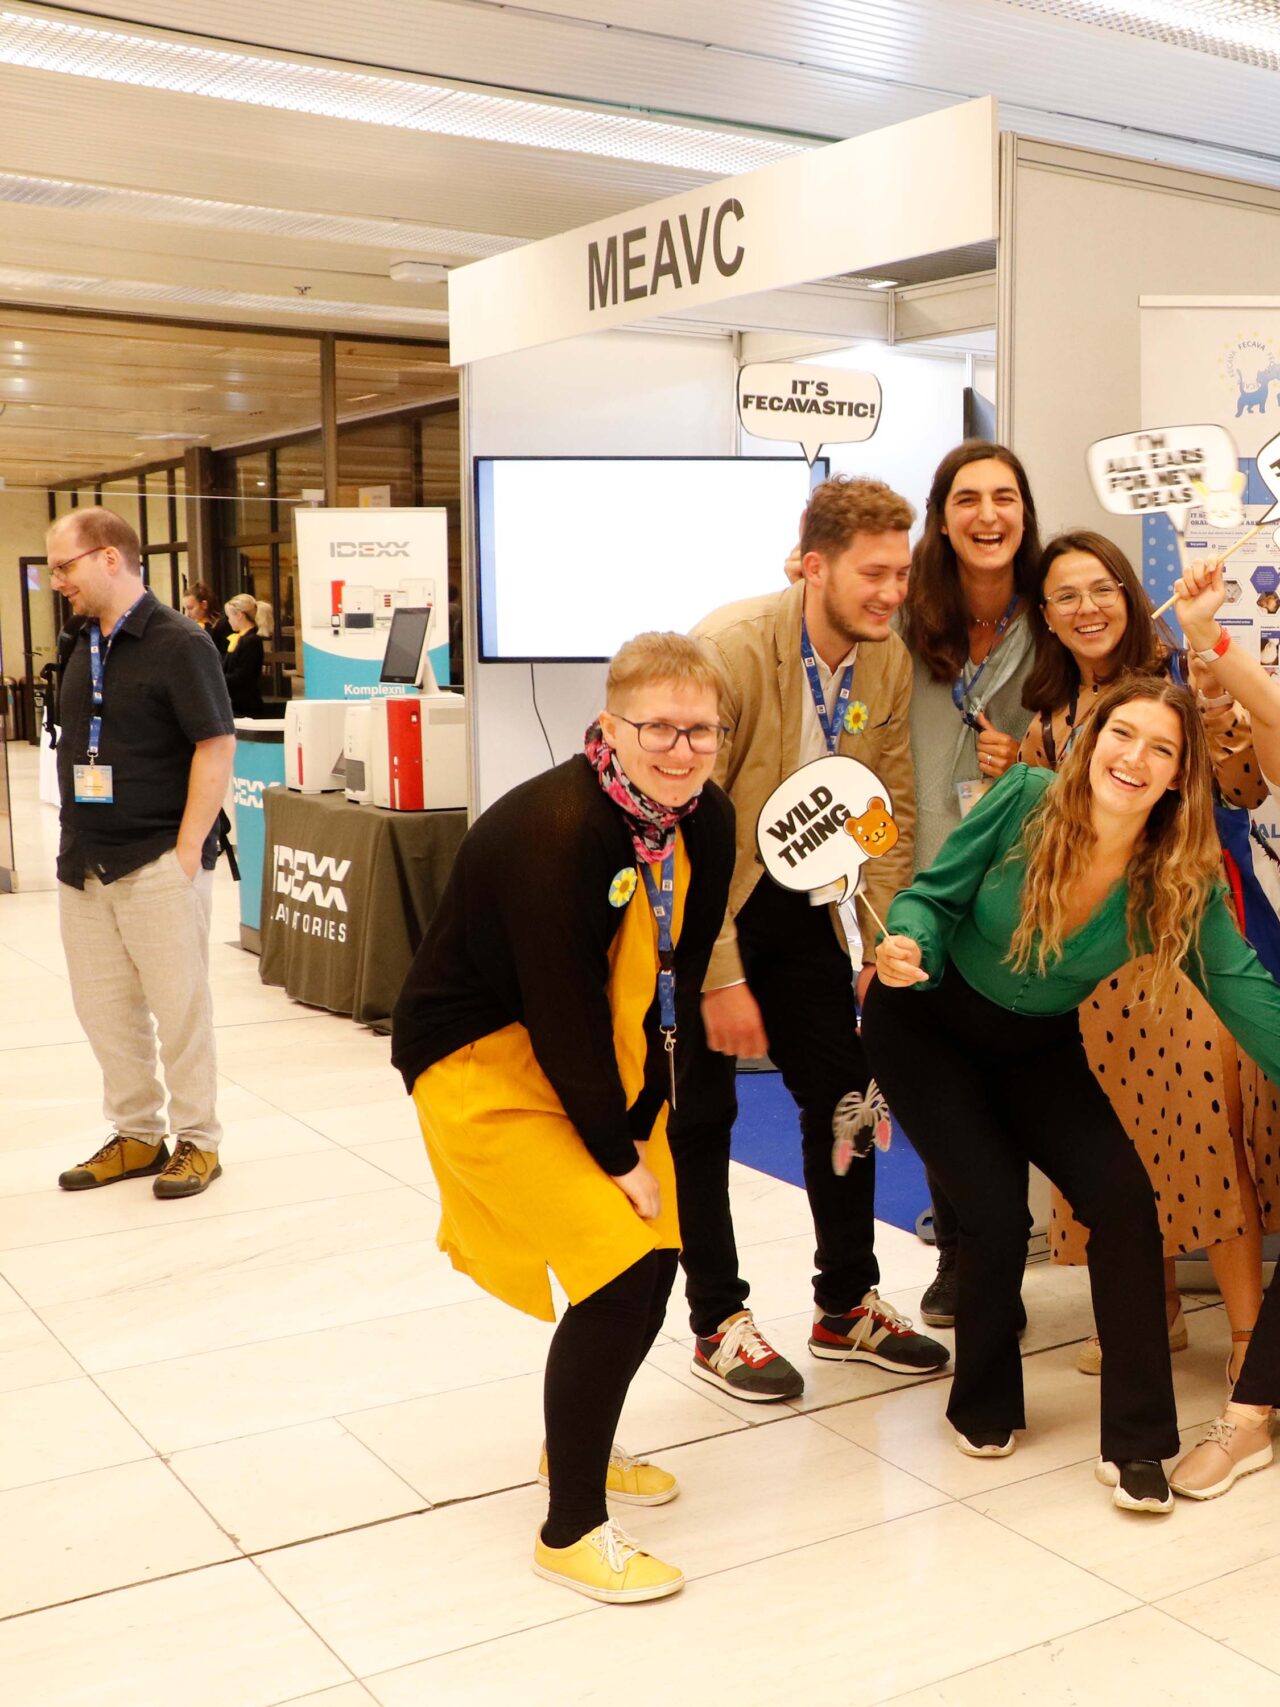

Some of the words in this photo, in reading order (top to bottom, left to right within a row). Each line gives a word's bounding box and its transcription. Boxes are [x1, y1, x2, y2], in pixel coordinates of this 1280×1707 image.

[588, 197, 745, 312] MEAVC
[742, 394, 876, 419] FECAVASTIC!
[791, 379, 829, 397] IT'S
[329, 541, 411, 558] IDEXX
[766, 785, 833, 843] WILD
[777, 803, 851, 869] THING
[272, 844, 352, 912] IDEXX
